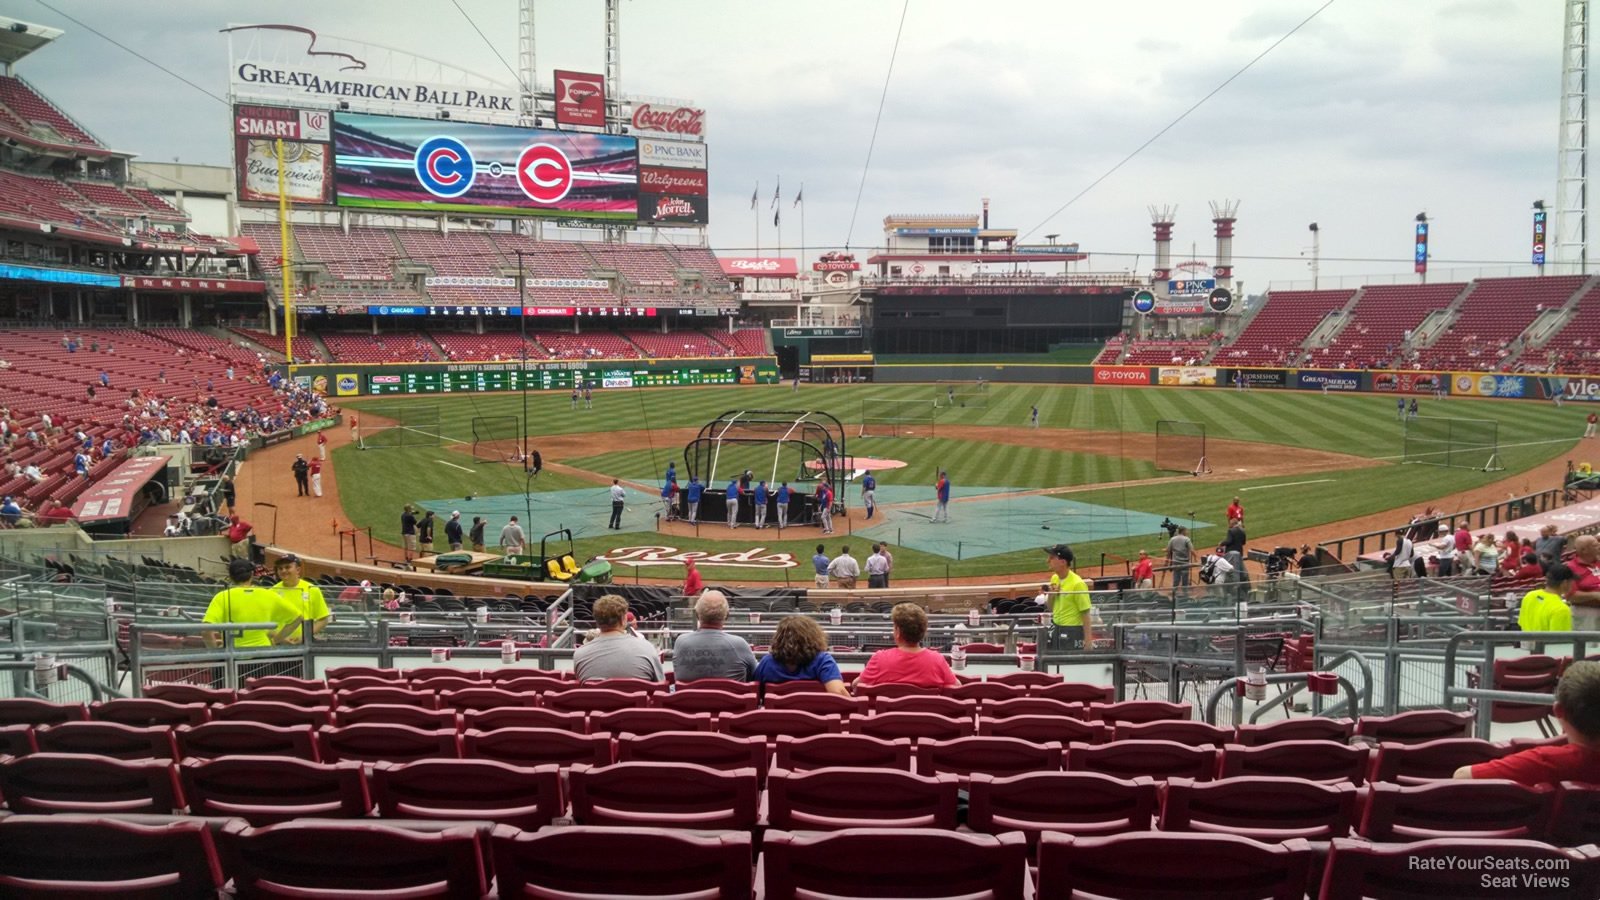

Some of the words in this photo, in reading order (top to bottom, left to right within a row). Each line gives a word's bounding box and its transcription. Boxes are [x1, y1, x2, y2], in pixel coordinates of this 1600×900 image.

[238, 63, 312, 86] GREAT
[306, 75, 411, 101] AMERICAN
[413, 85, 459, 107] BALL
[465, 90, 513, 111] PARK
[240, 118, 297, 137] SMART
[655, 146, 676, 156] PNC
[677, 147, 702, 157] BANK
[642, 172, 704, 189] Walgreens
[668, 197, 685, 206] John
[653, 202, 695, 218] Morrell
[1185, 280, 1207, 289] PNC
[1112, 371, 1146, 380] TOYOTA
[1302, 375, 1325, 383] GREAT
[597, 545, 800, 568] Reds
